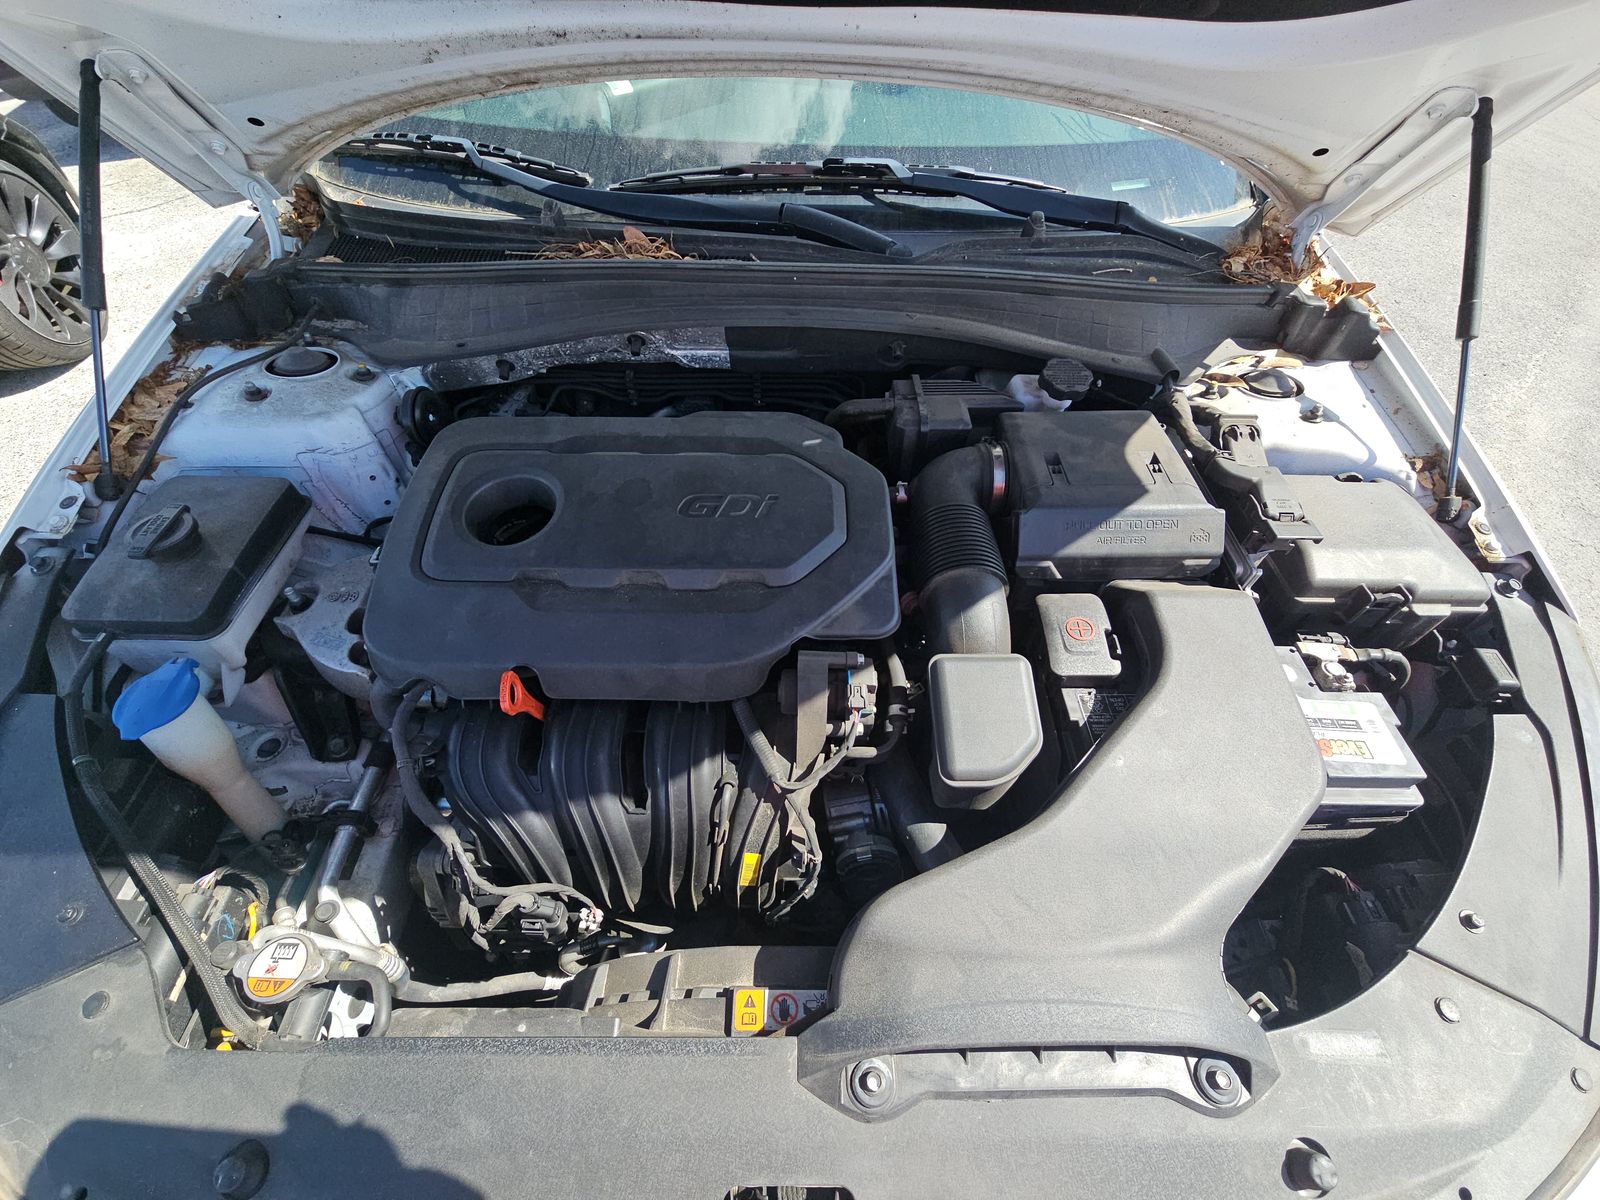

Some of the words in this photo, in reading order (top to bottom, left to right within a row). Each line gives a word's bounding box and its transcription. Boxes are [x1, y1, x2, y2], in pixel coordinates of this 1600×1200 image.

[1099, 519, 1123, 530] OUT
[1126, 519, 1143, 529] TO
[1146, 519, 1179, 529] OPEN
[1096, 536, 1113, 544] AIR
[1115, 536, 1147, 544] FILTER
